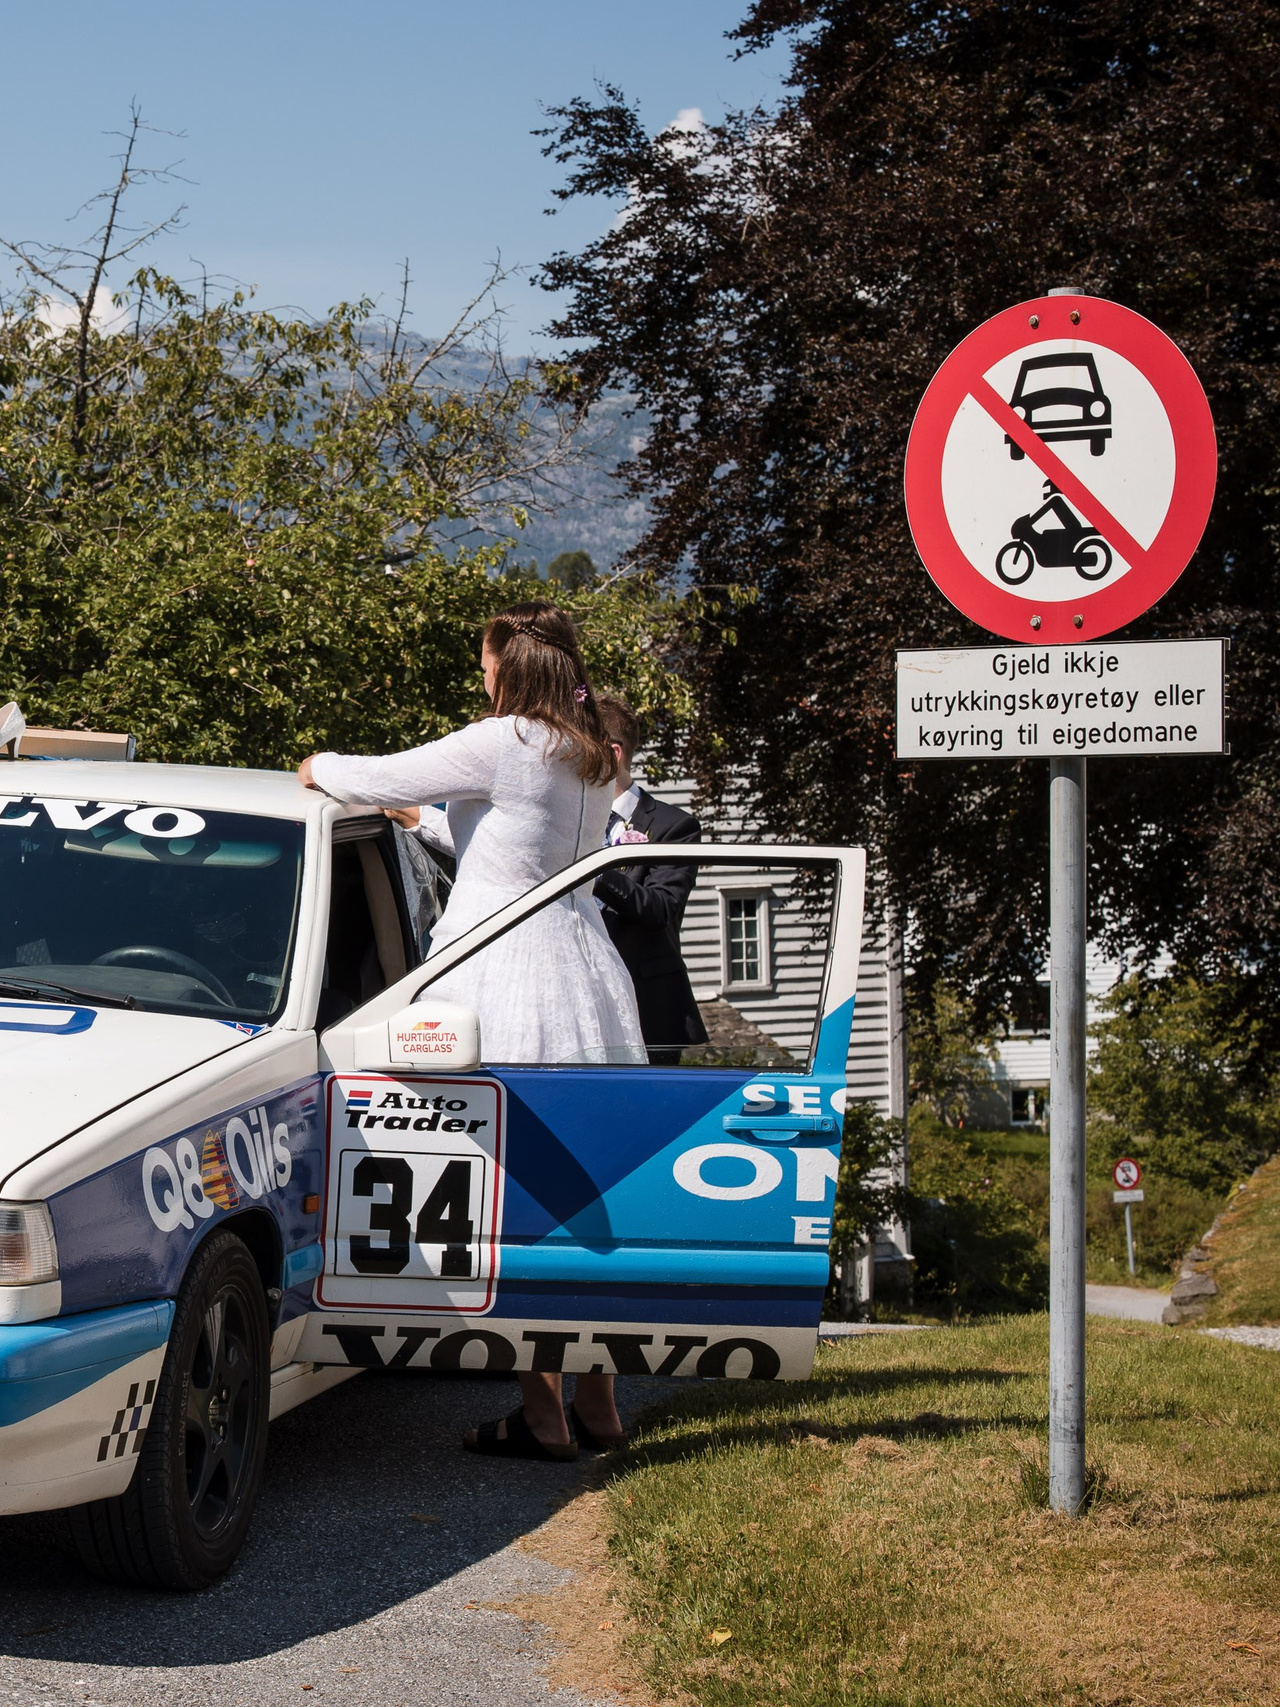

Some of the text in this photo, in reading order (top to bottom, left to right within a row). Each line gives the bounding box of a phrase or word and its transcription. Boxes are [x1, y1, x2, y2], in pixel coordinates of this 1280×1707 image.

[992, 651, 1119, 681] Gjeld ikkje
[911, 684, 1206, 717] utrykkingskøyretøy eller
[918, 722, 1198, 752] køyring til eigedomane
[396, 1032, 458, 1042] HURTIGRUTA
[377, 1092, 468, 1112] Auto
[344, 1109, 489, 1134] Trader
[142, 1105, 292, 1233] Q8 Oils
[349, 1156, 475, 1278] 34
